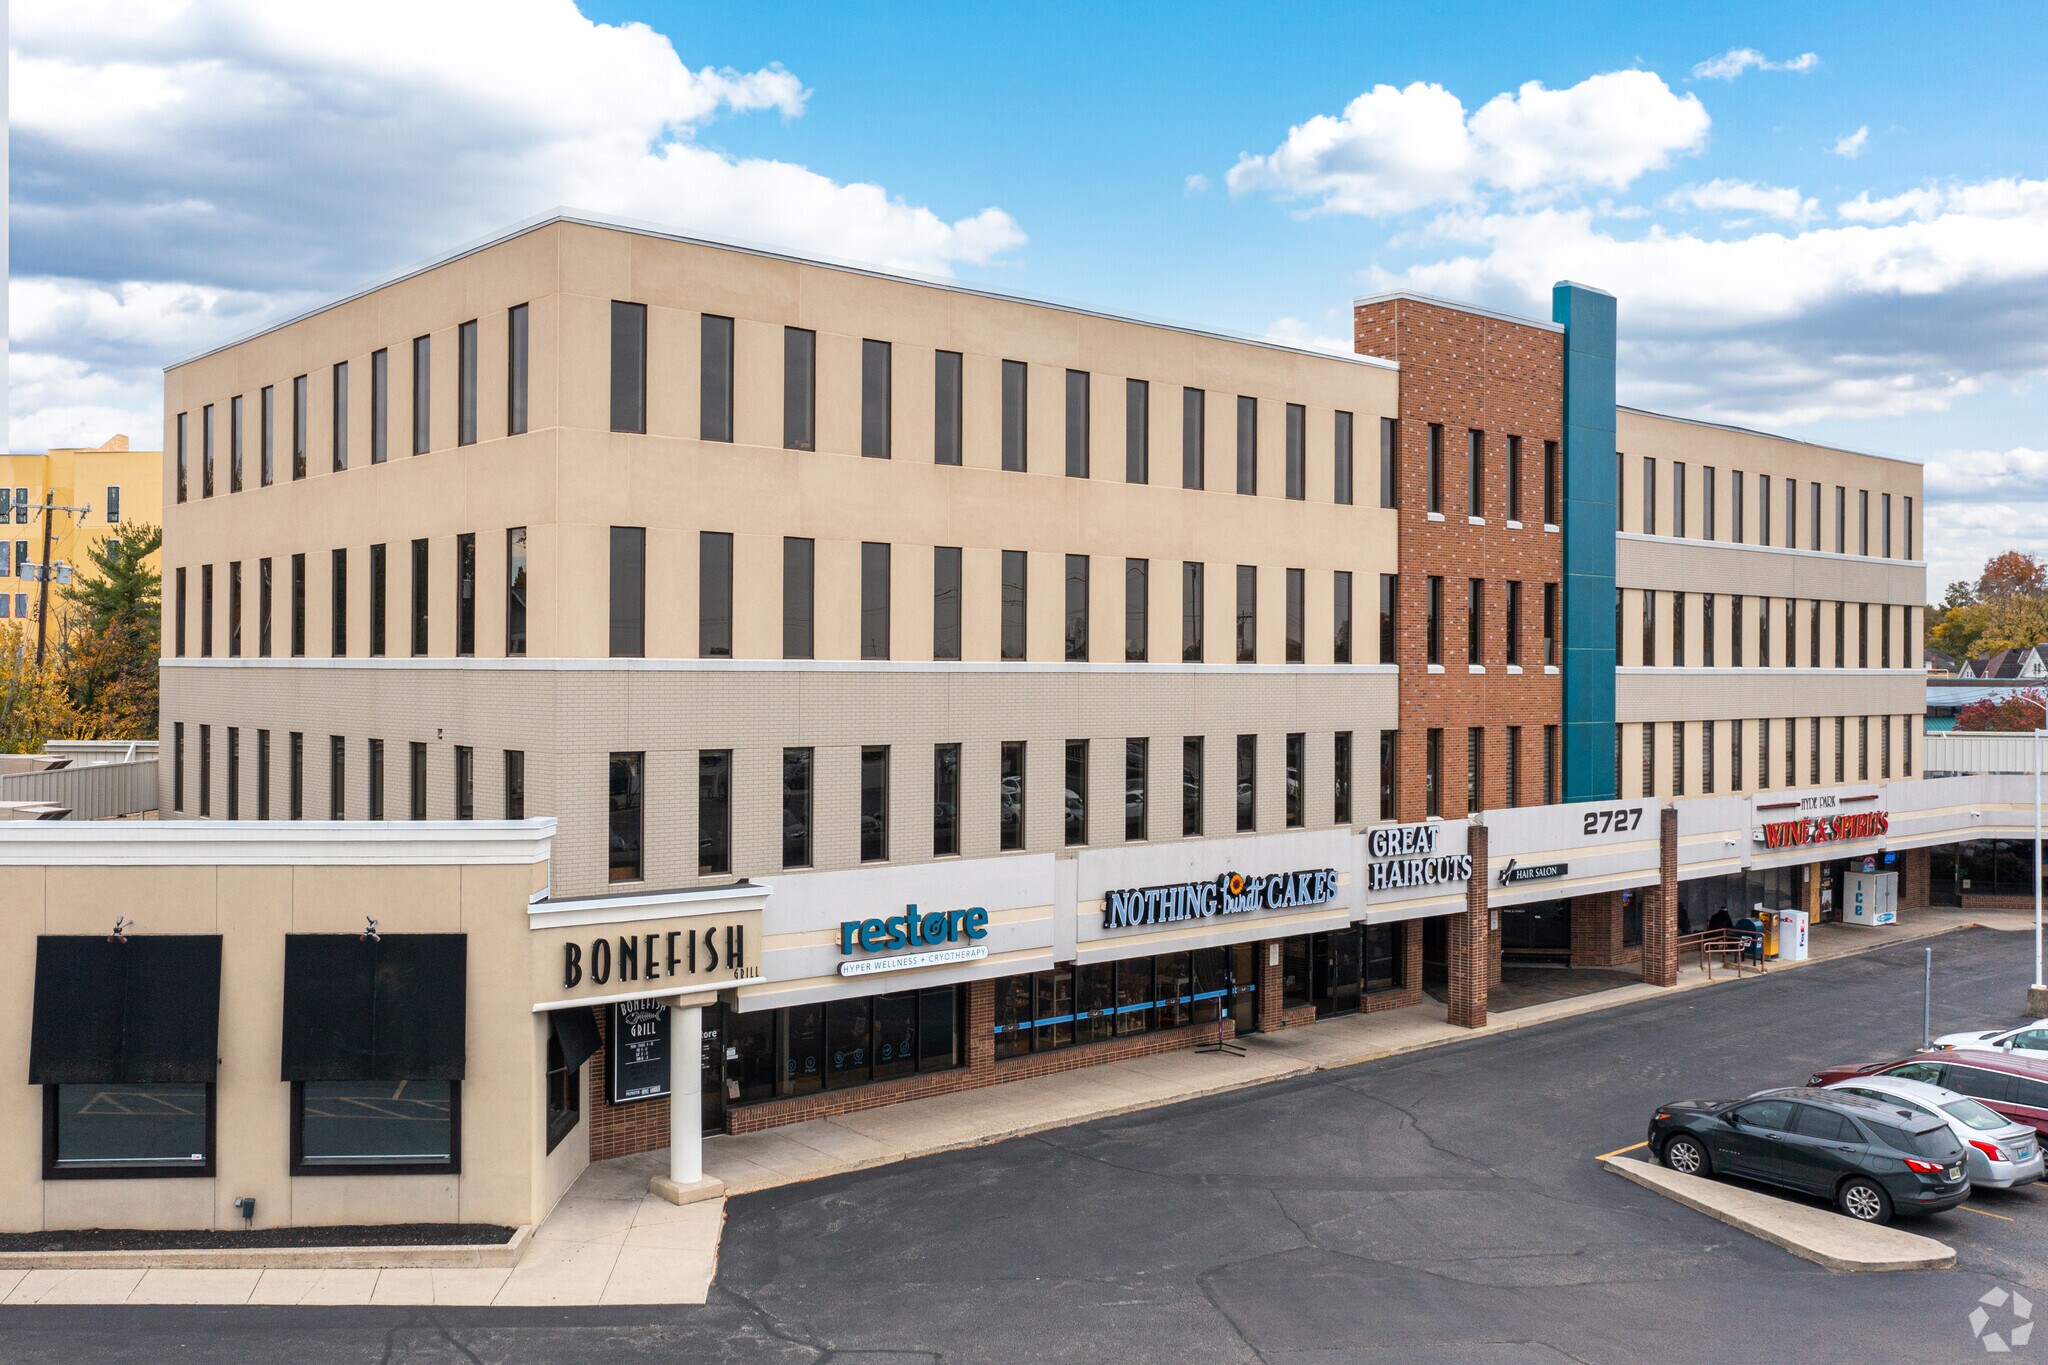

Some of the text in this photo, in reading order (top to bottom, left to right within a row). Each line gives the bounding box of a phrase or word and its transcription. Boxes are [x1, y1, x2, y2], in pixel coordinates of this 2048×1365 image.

[1801, 795, 1836, 810] HYDE PARK
[1583, 808, 1643, 835] 2727
[1764, 811, 1889, 849] WINE & SPIRITS
[1371, 825, 1440, 857] GREAT
[1371, 854, 1473, 890] HAIRCUTS
[1516, 866, 1558, 880] HAIR SALON
[1107, 870, 1339, 929] NOTHING bundt CAKES
[840, 903, 989, 955] restore
[564, 924, 744, 989] BONEFISH
[843, 963, 871, 973] HYPER
[874, 956, 917, 969] WELLNESS
[928, 948, 986, 963] CRYOTHERAPY
[734, 966, 760, 979] GRILL
[631, 1022, 656, 1037] GRILL
